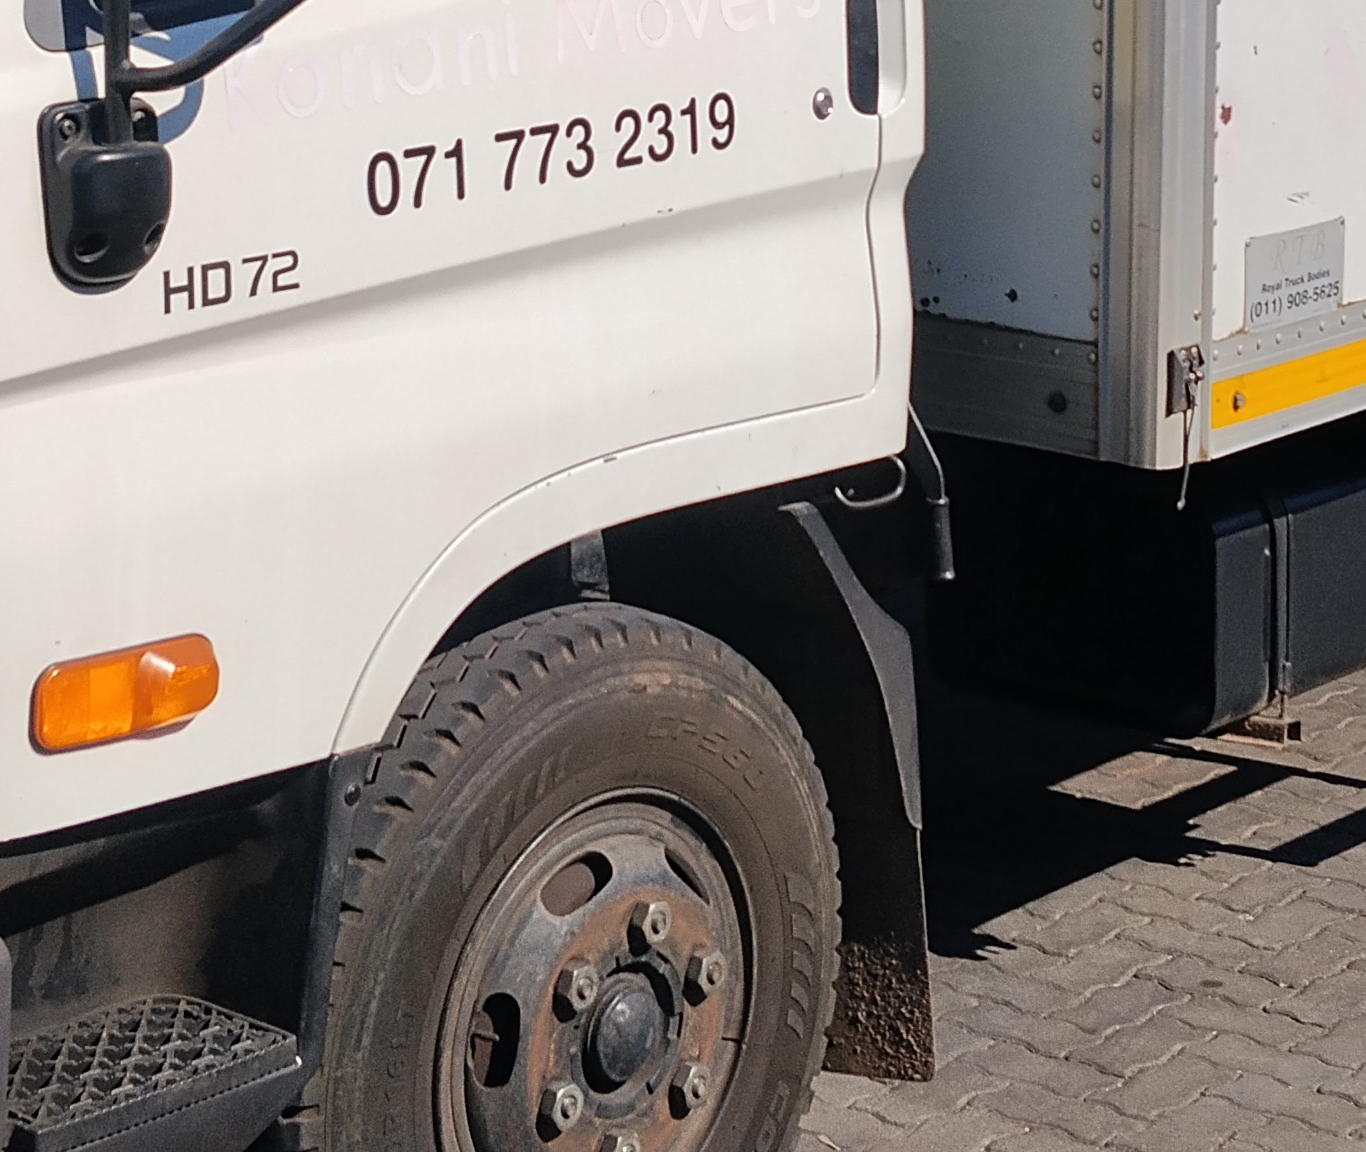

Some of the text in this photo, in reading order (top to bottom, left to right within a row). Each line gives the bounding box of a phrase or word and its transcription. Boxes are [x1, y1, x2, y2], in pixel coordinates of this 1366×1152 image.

[367, 92, 736, 216] 071 773 2319
[1250, 280, 1340, 323] (011) 908-5625
[1261, 268, 1331, 295] Royal Truck Bodies
